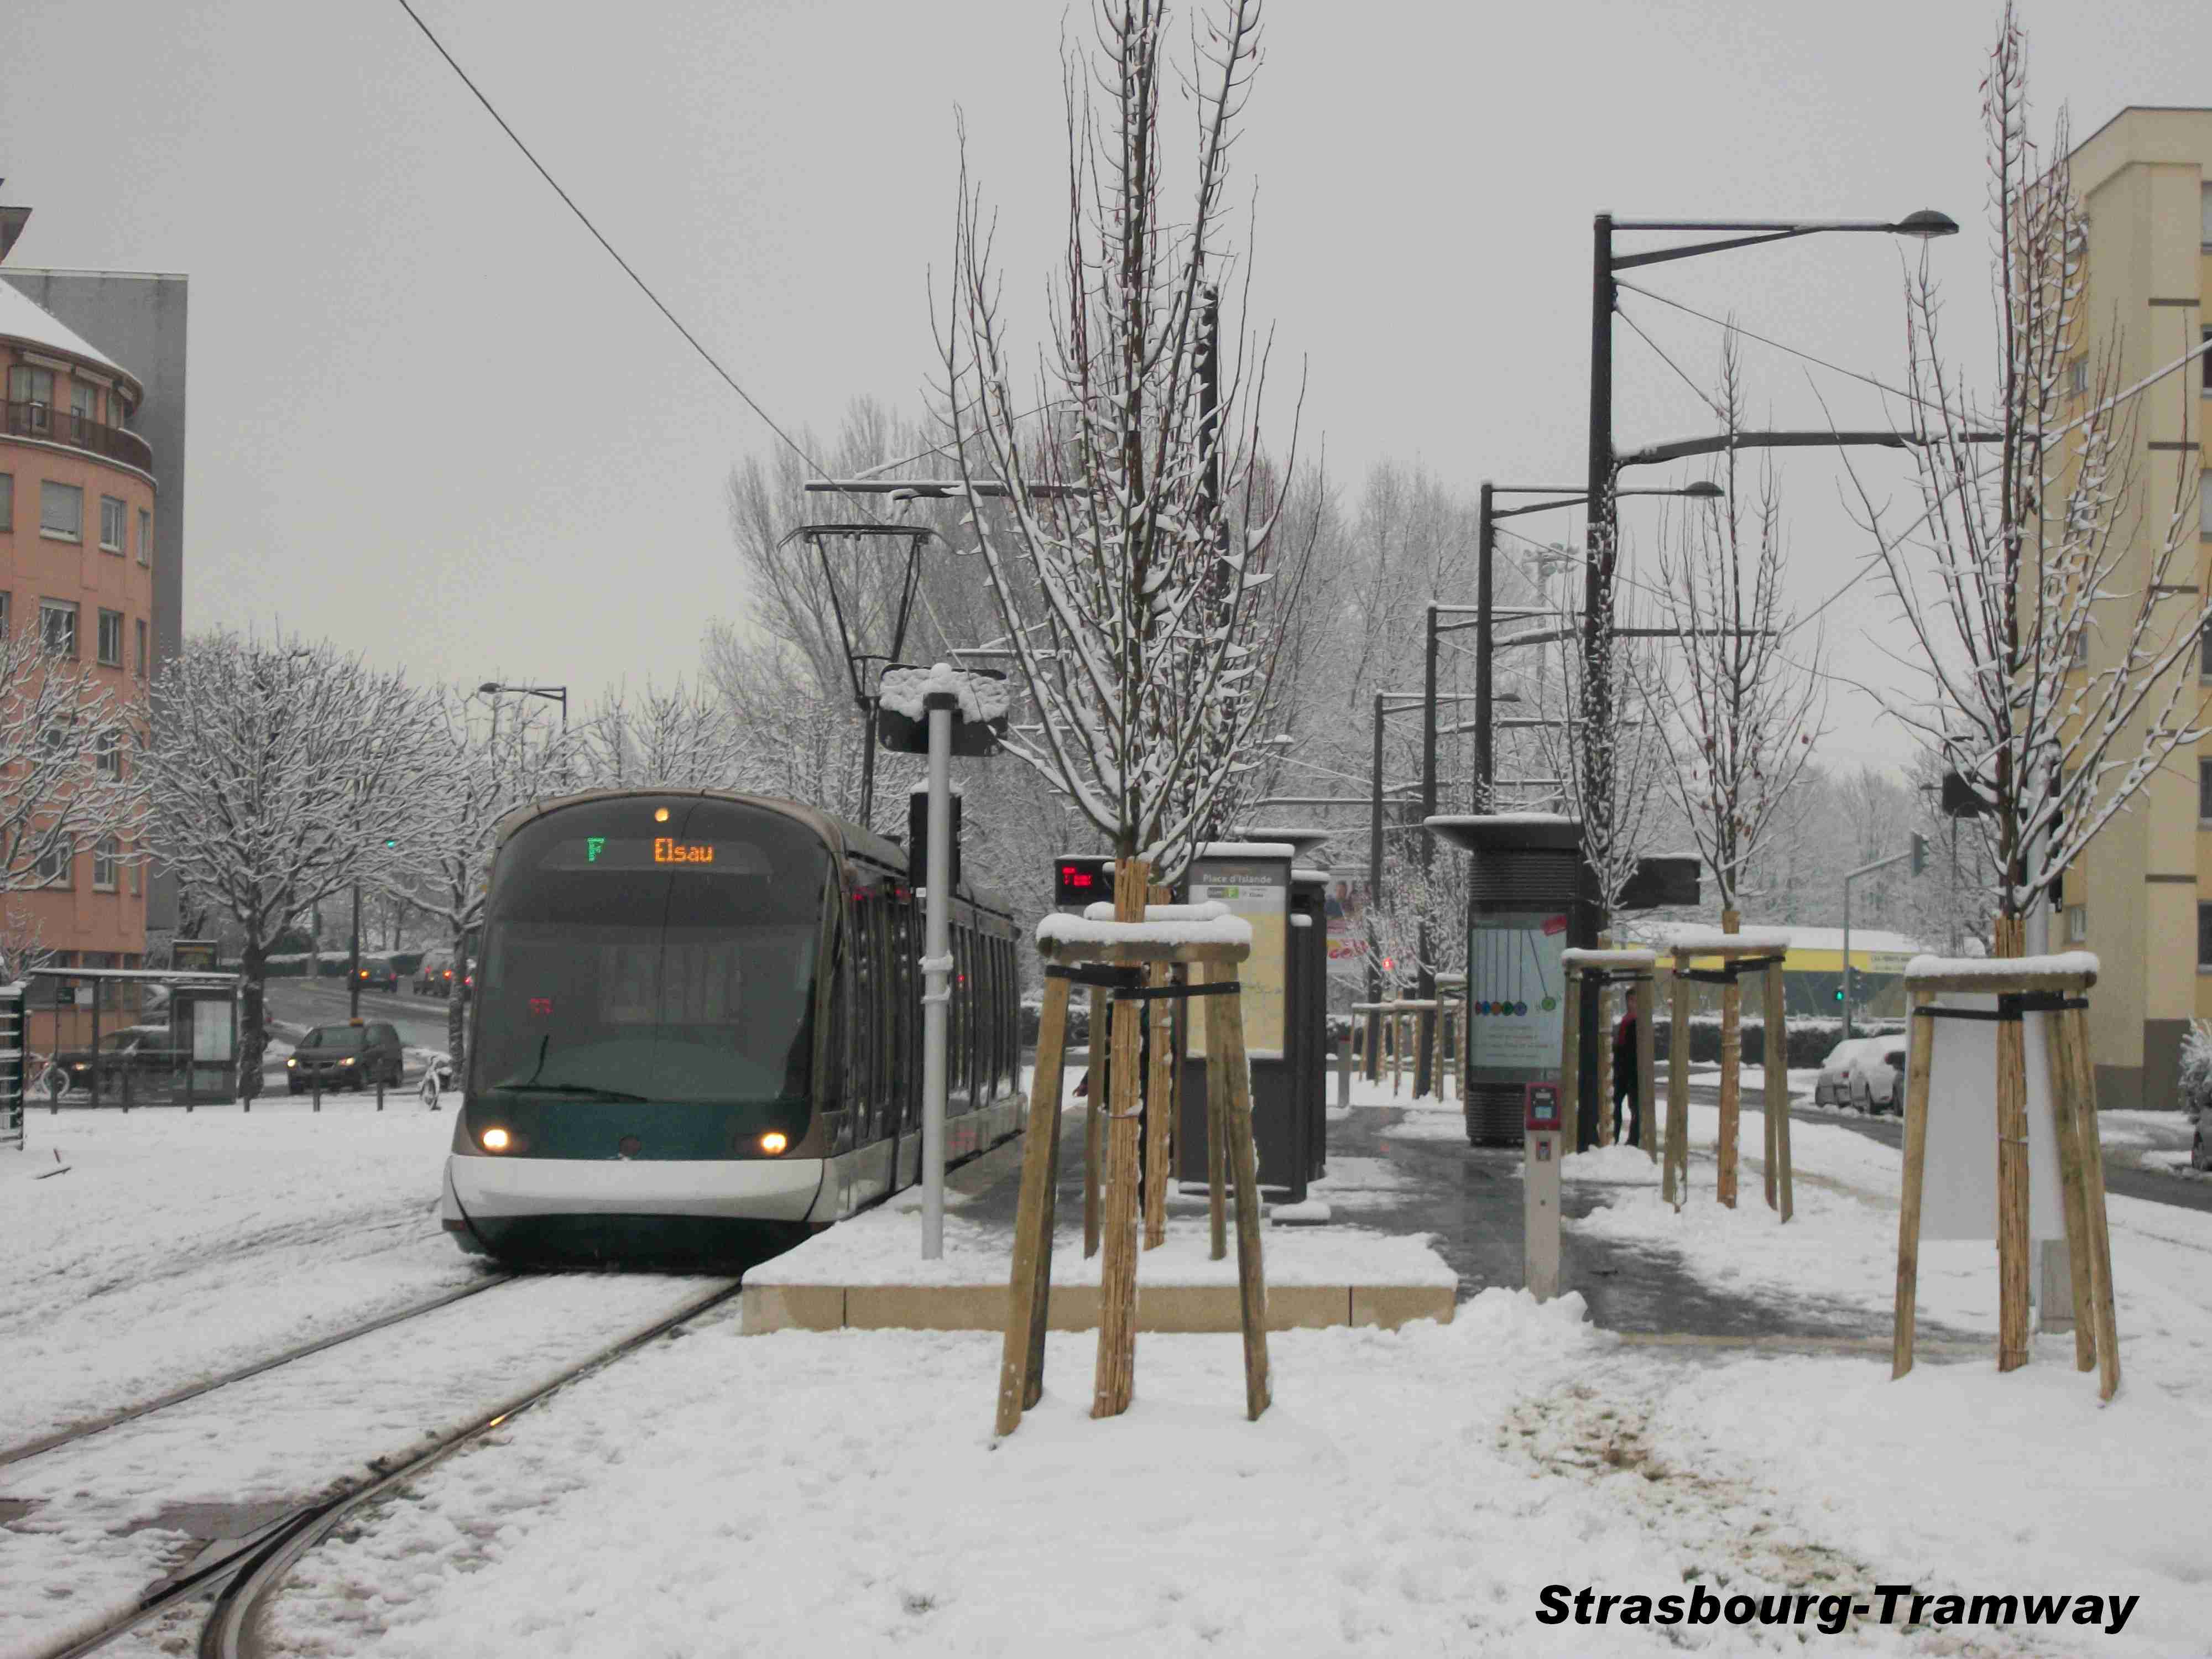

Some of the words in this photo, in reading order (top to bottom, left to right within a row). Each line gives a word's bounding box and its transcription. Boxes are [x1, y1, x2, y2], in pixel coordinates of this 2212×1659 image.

[587, 838, 604, 862] F
[655, 838, 713, 862] Elsau
[1203, 874, 1227, 883] Place
